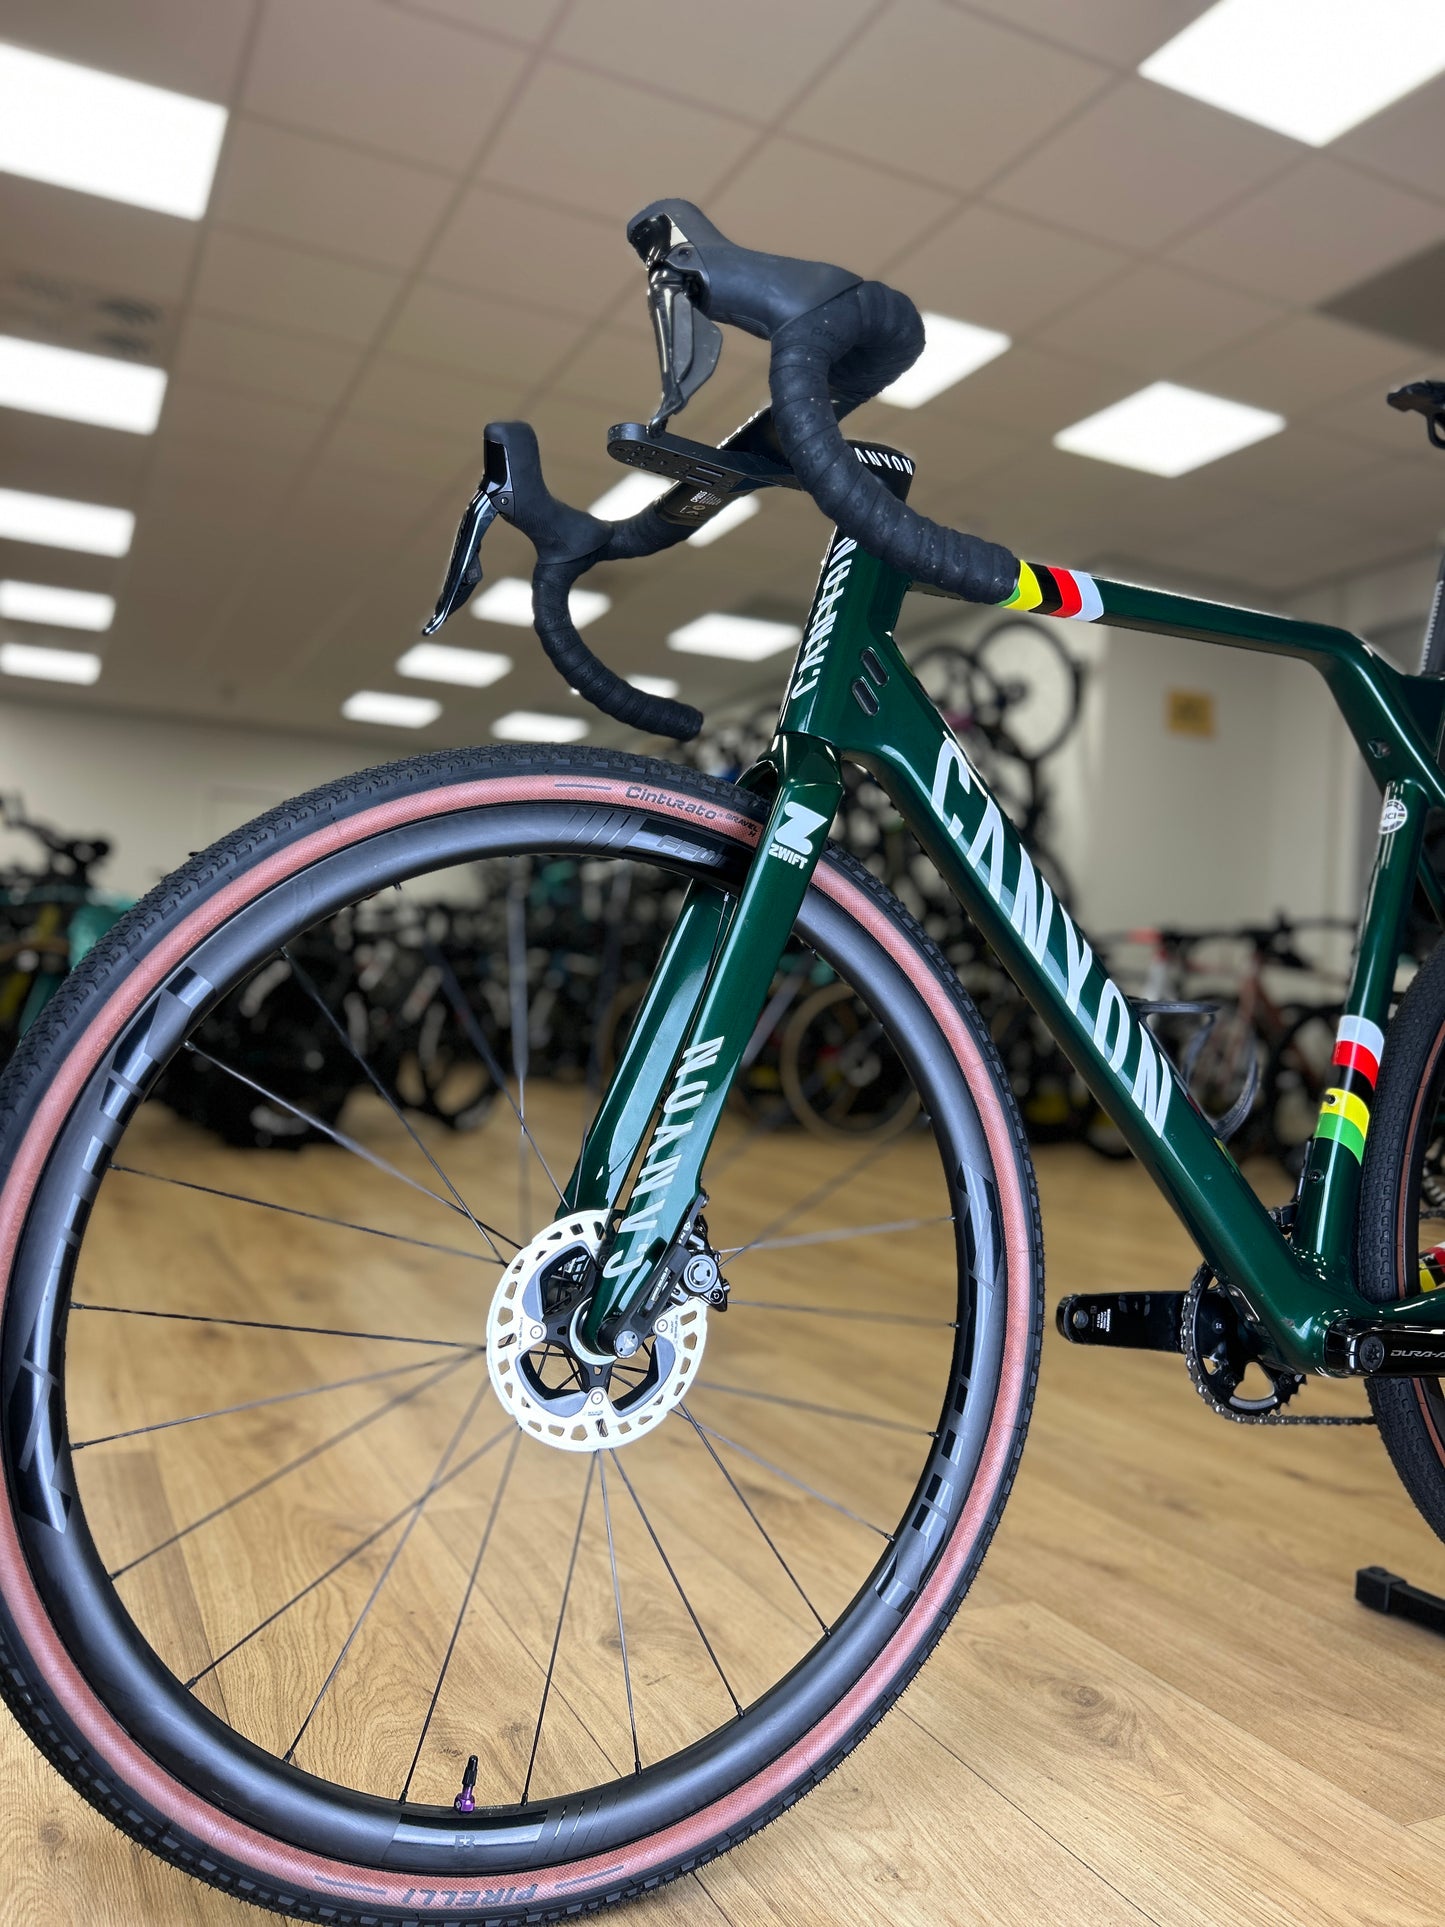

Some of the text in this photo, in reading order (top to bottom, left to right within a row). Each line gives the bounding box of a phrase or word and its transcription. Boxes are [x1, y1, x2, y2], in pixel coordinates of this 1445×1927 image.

[854, 447, 913, 476] ANYON
[791, 537, 858, 699] CANYON
[625, 785, 717, 819] Cinturato
[657, 834, 729, 868] FFW
[768, 842, 808, 869] ZWIFT
[931, 737, 1172, 1138] CANYON
[603, 1036, 725, 1279] CANYON
[401, 1884, 538, 1906] PIRELLI
